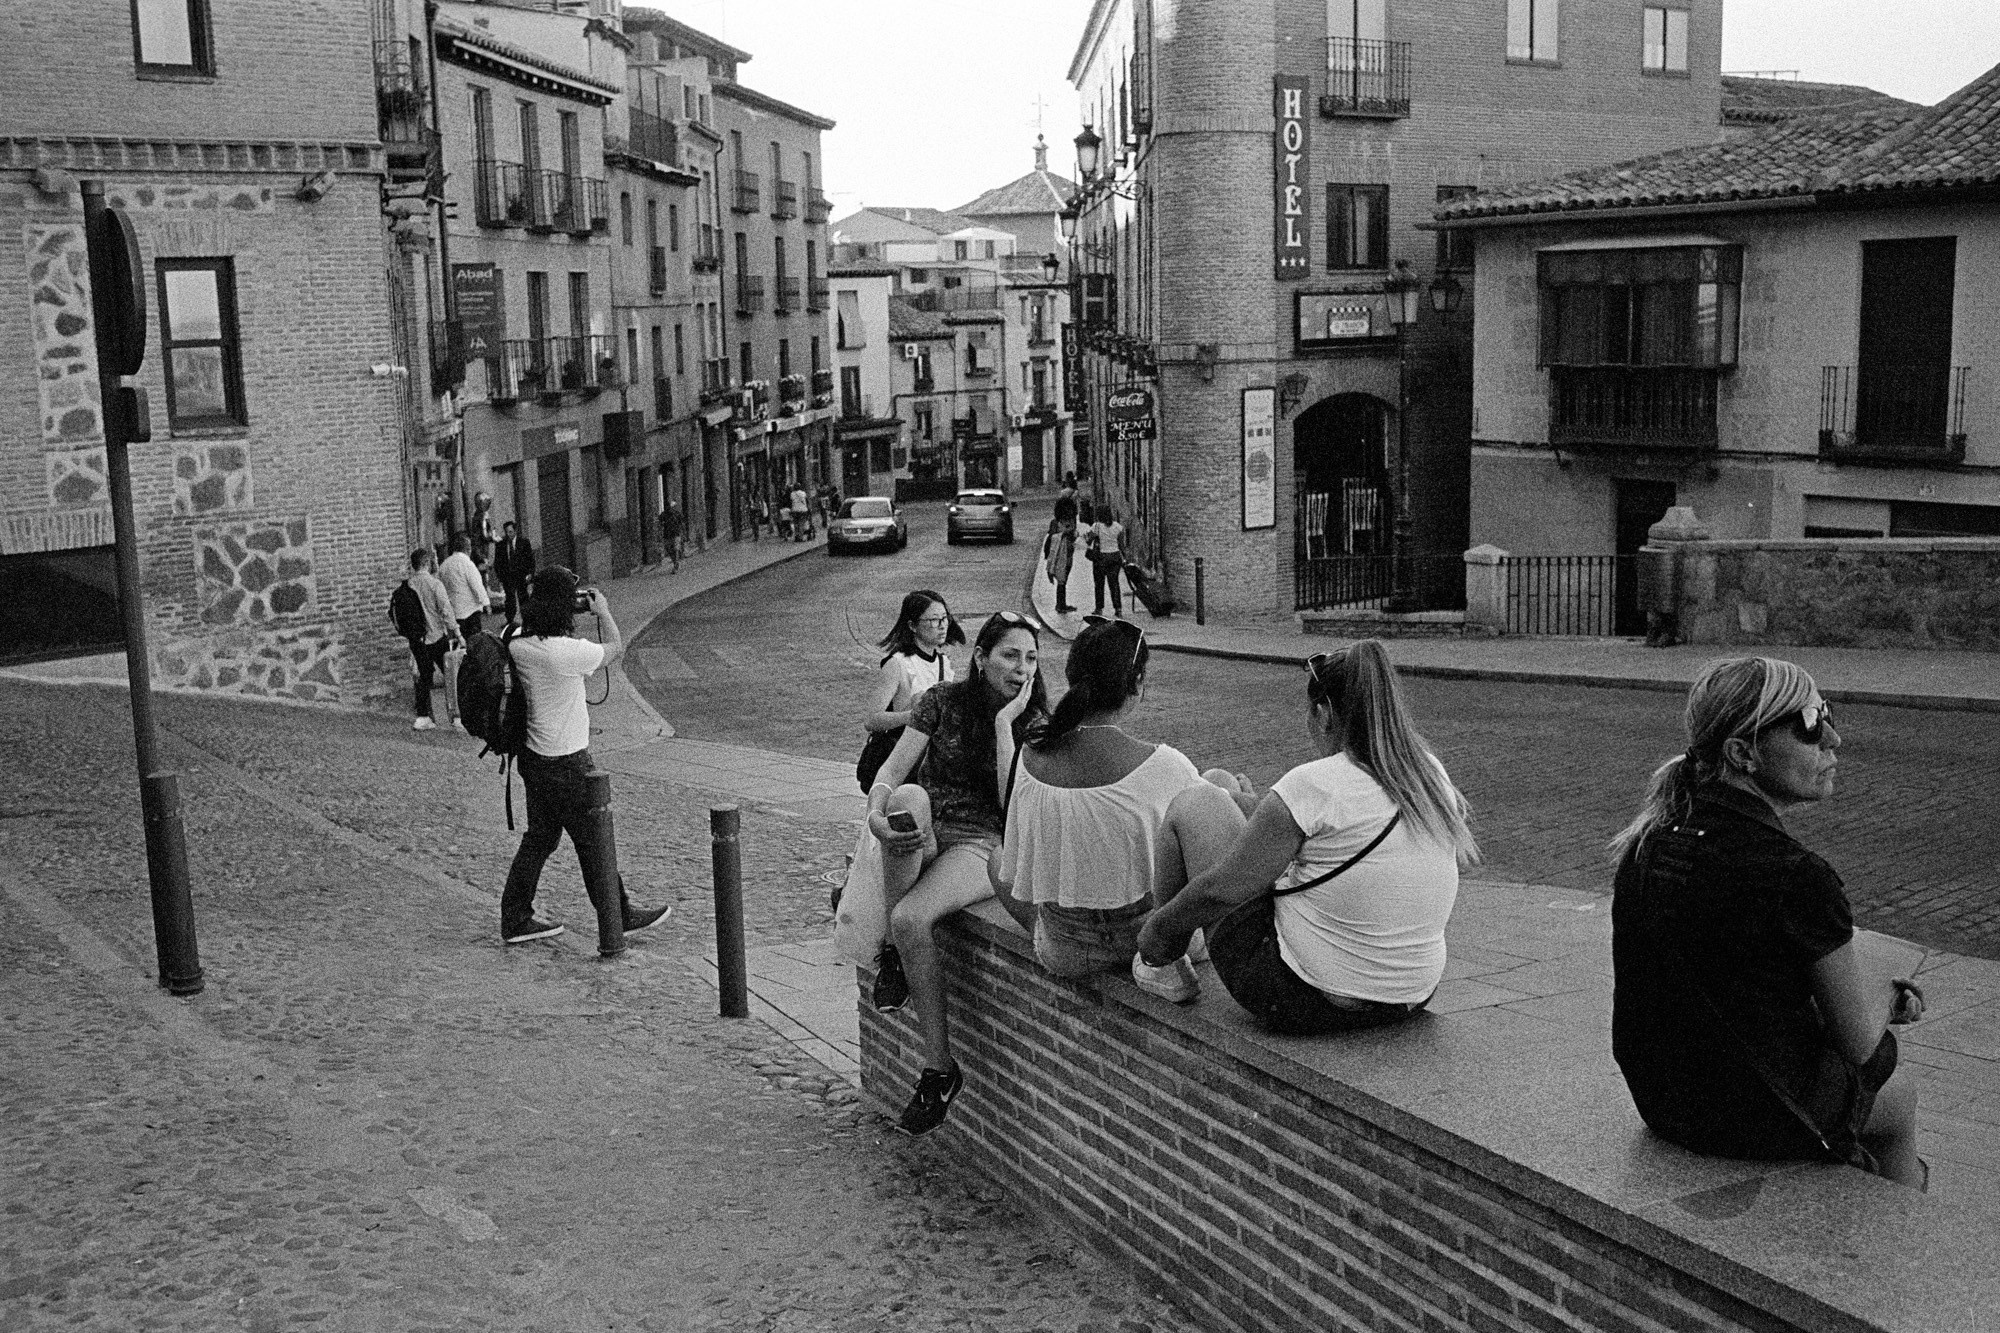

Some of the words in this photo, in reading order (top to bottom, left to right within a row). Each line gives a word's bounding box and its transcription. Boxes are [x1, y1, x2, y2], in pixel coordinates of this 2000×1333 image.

[1283, 88, 1303, 248] HOTEL
[457, 268, 493, 279] Abad
[1066, 328, 1079, 399] HOTEL
